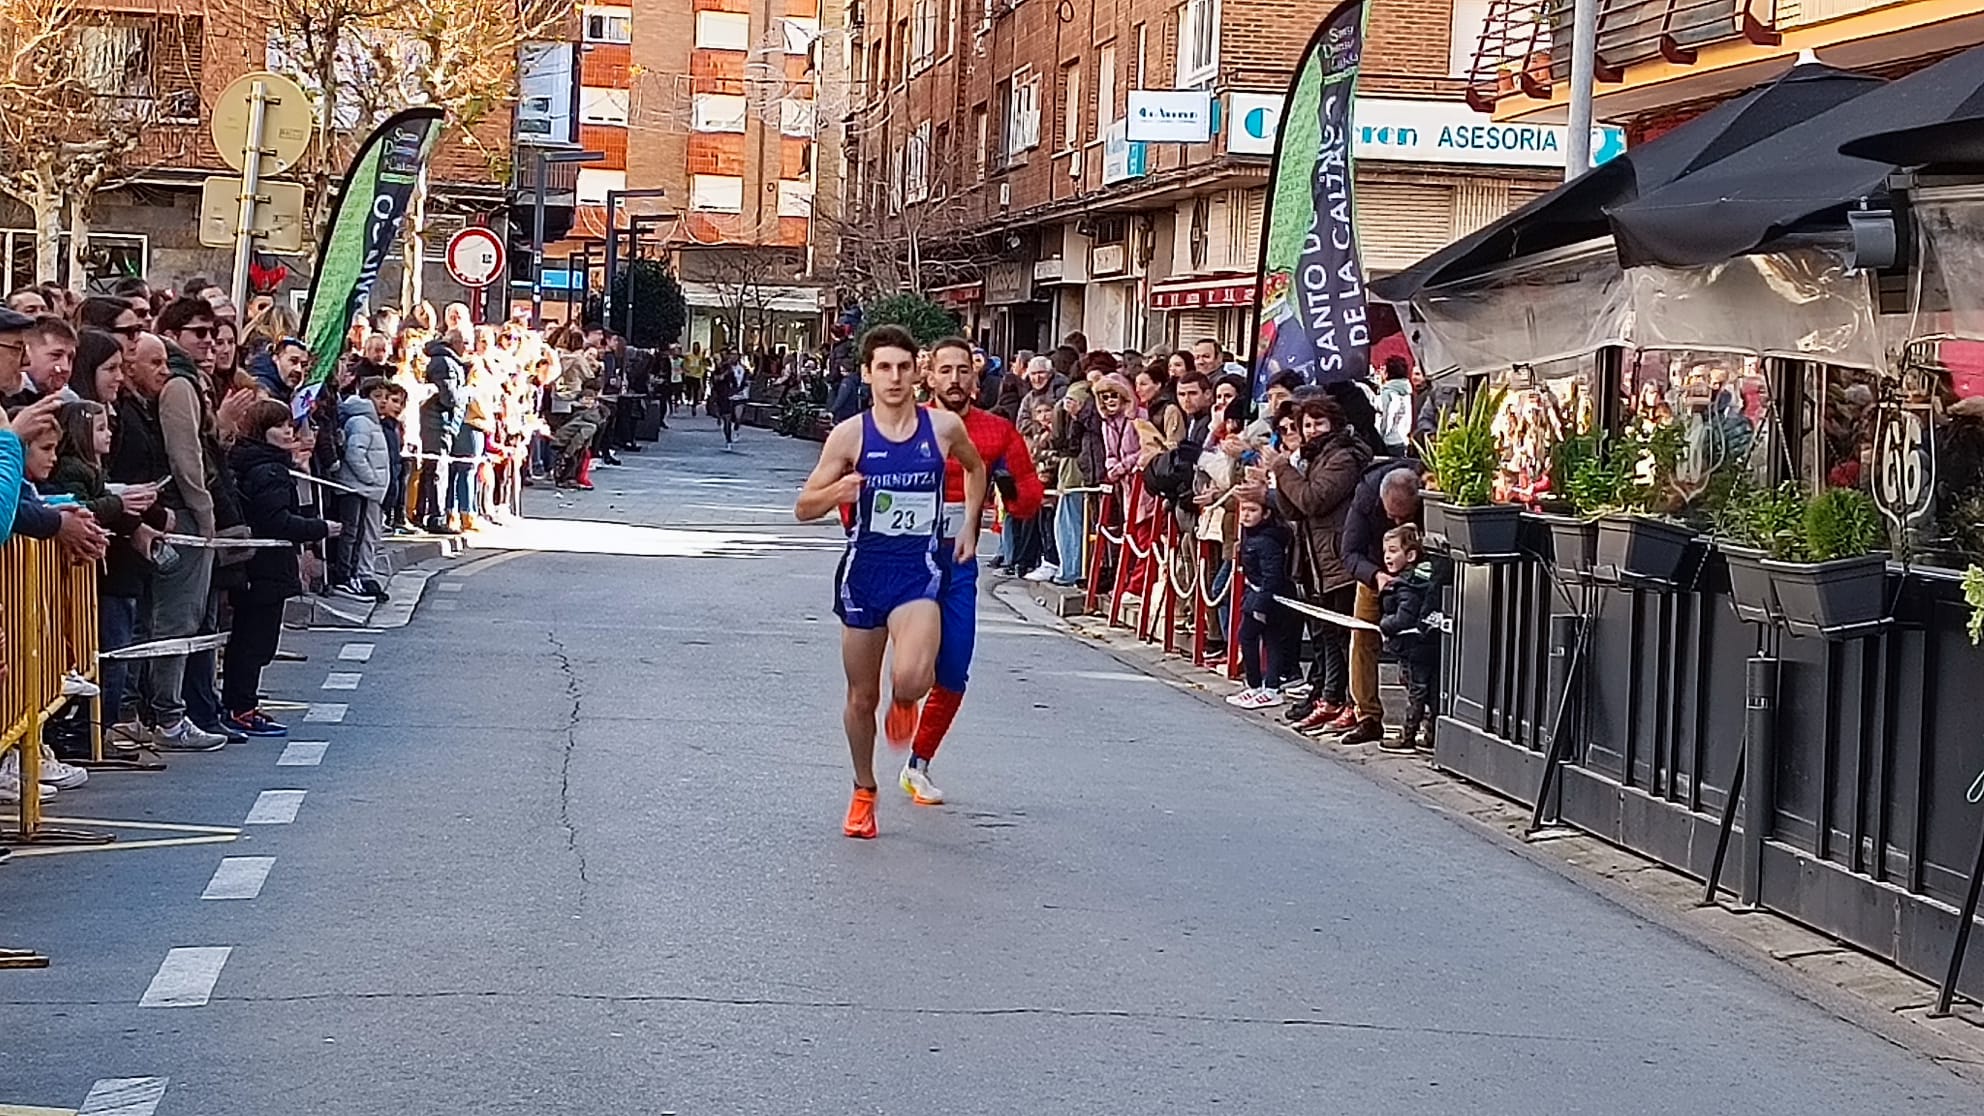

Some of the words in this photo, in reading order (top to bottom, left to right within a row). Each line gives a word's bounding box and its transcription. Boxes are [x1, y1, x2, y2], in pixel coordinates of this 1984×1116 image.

[1337, 259, 1360, 299] LA
[1303, 264, 1343, 371] SANTO
[1343, 306, 1370, 347] DE
[1882, 410, 1922, 505] 66
[891, 510, 916, 530] 23
